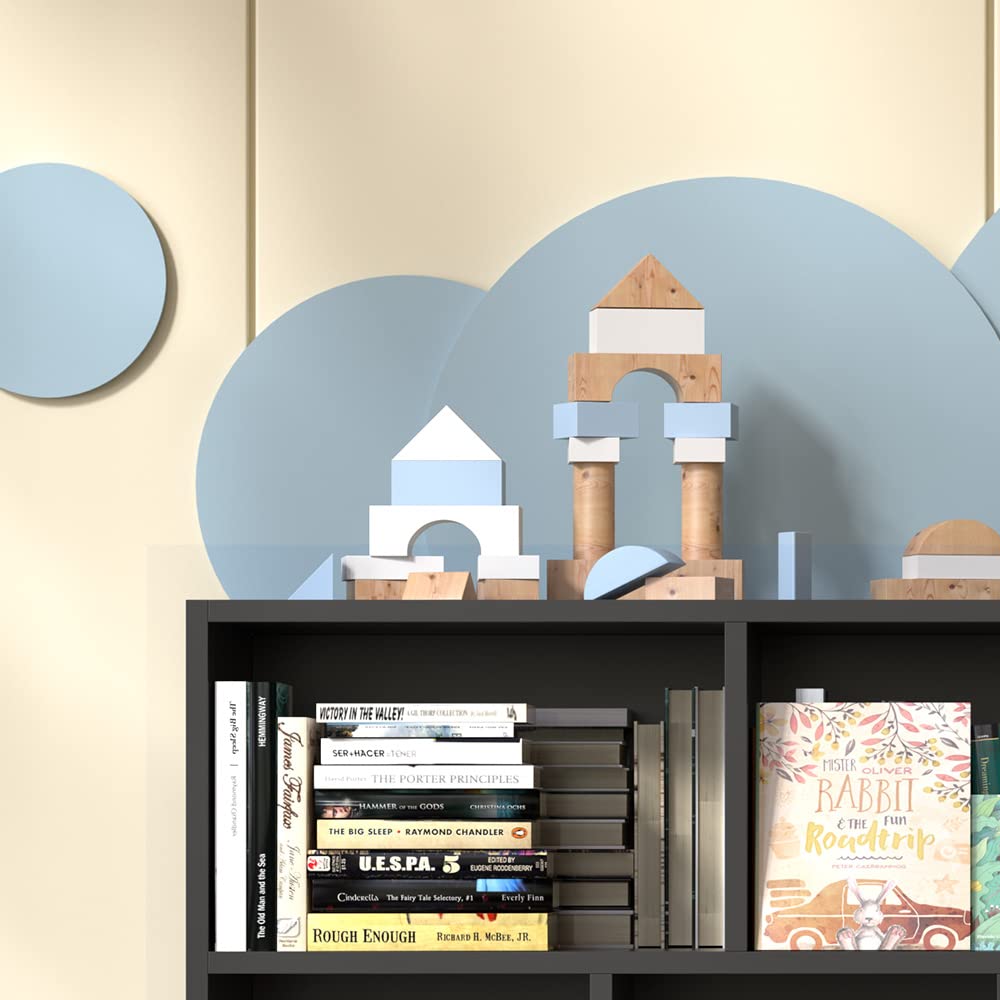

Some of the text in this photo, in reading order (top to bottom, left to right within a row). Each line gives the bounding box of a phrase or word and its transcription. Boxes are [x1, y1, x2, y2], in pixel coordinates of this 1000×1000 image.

[319, 707, 404, 721] VICTORY IN THE VALLEY!
[258, 696, 267, 747] HEMMINGWAY
[823, 758, 913, 775] MISTER OLIVER
[371, 774, 520, 784] THE PORTER PRINCIPLES
[815, 774, 919, 814] RABBIT
[358, 803, 397, 811] HAMMER
[419, 803, 444, 811] GODS
[847, 818, 868, 830] THE
[328, 828, 393, 836] THE BIG SLEEP
[405, 828, 504, 836] RAYMOND CHANDLER
[804, 820, 936, 860] Roadtrip
[358, 855, 461, 874] U.E.S.P.A. 5
[488, 856, 516, 864] EDITED BY
[257, 853, 266, 939] The Old Man and the Sea
[386, 894, 399, 902] The
[400, 894, 416, 903] Fairy
[417, 894, 432, 902] Tale
[465, 894, 474, 902] #1
[501, 894, 544, 903] Everly Finn
[312, 928, 416, 944] ROUGH ENOUGH
